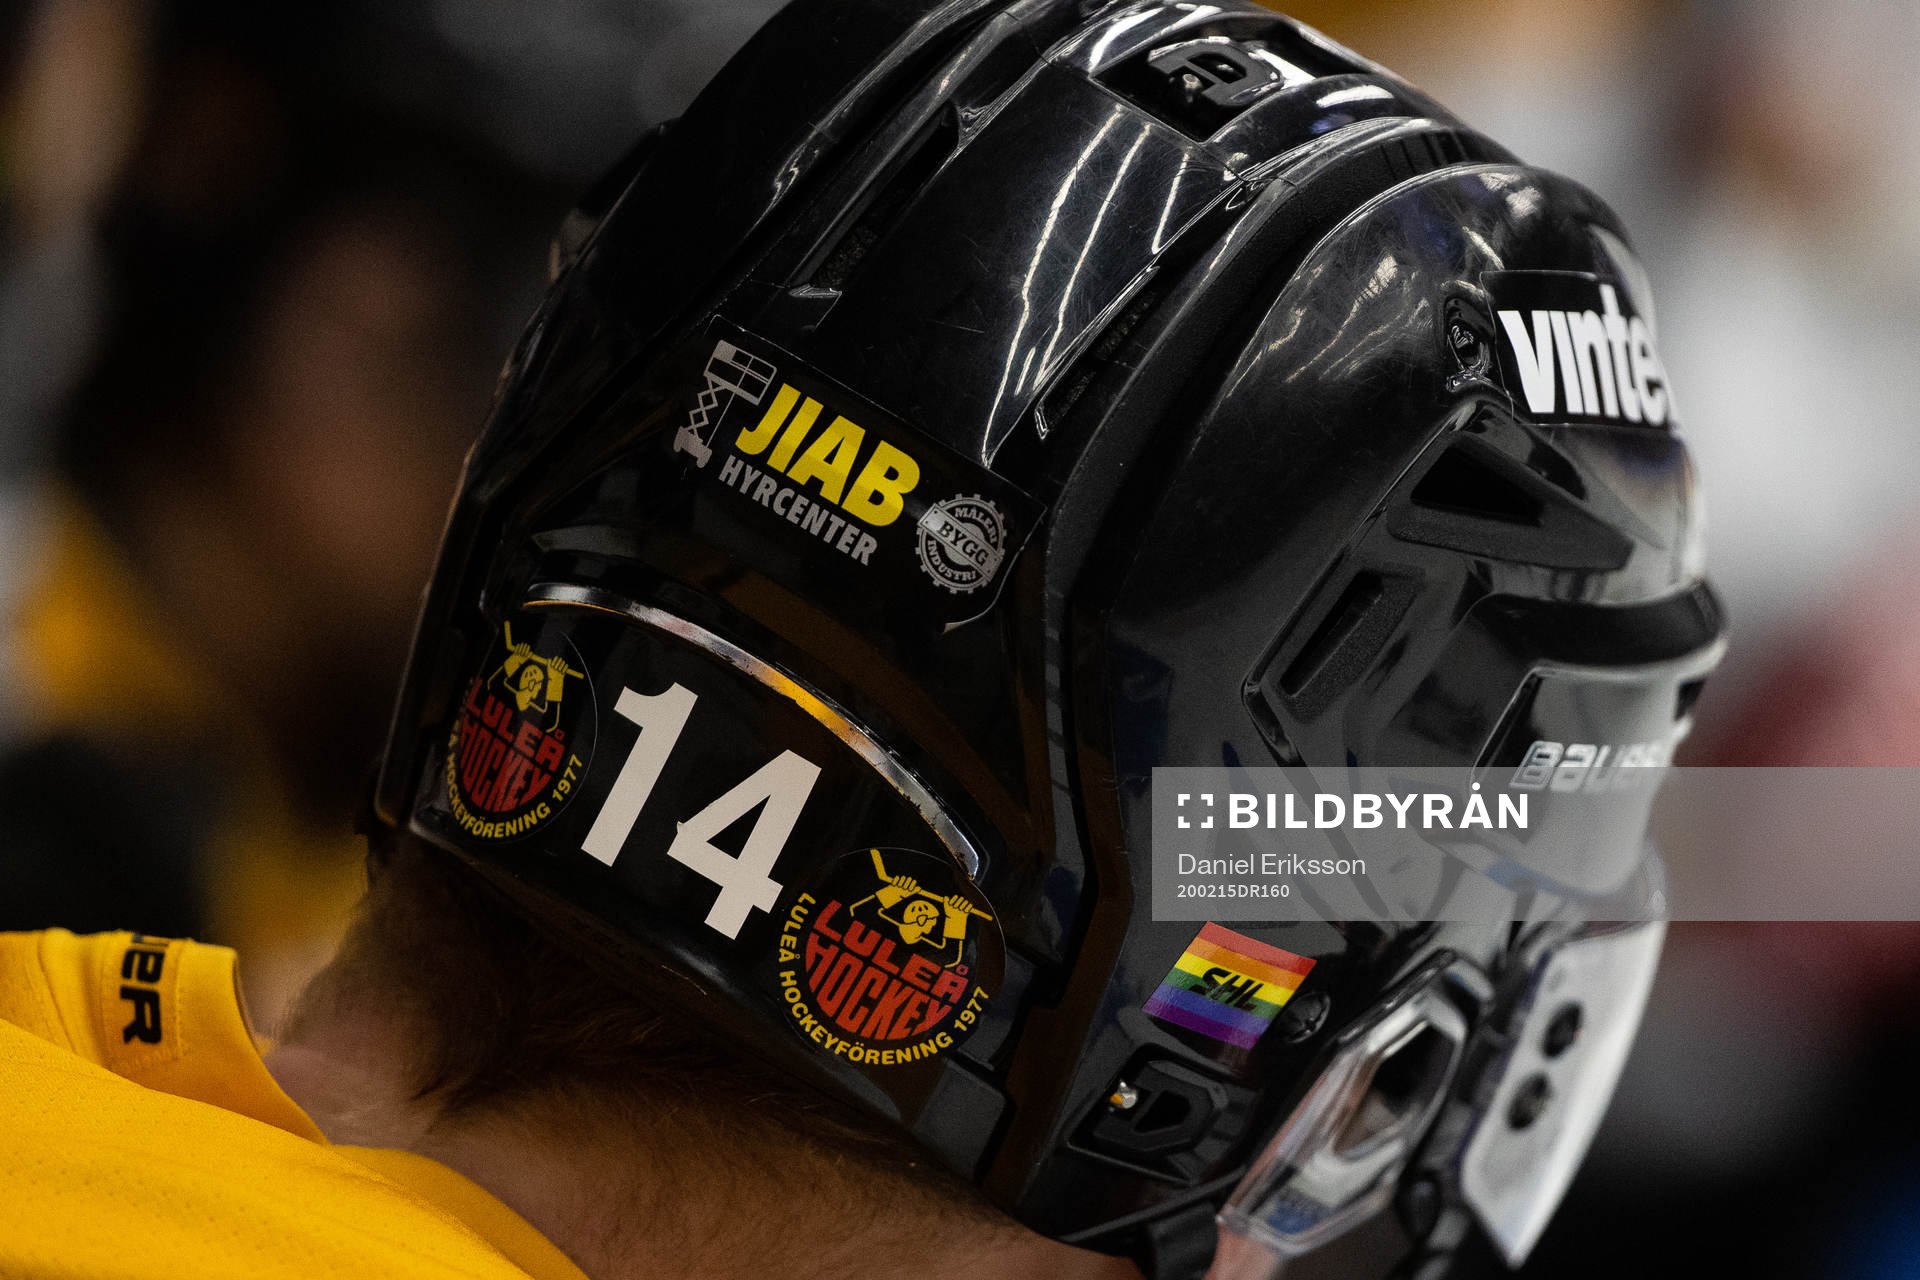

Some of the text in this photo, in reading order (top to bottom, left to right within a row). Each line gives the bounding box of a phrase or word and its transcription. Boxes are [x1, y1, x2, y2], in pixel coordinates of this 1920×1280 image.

[736, 383, 920, 527] JIAB
[718, 455, 878, 566] HYRCENTER
[927, 539, 977, 581] INDUSTRI
[937, 520, 990, 566] BYGG
[459, 713, 553, 813] HOCKEY
[466, 676, 567, 773] LULEÅ
[552, 753, 583, 802] 1977
[581, 682, 822, 940] 14
[778, 892, 990, 1066] LULEÅ HOCKEYFÖRENING 1977
[805, 931, 953, 1041] HOCKEY
[812, 899, 969, 1004] LULEÅ
[1188, 966, 1265, 1012] SHL
